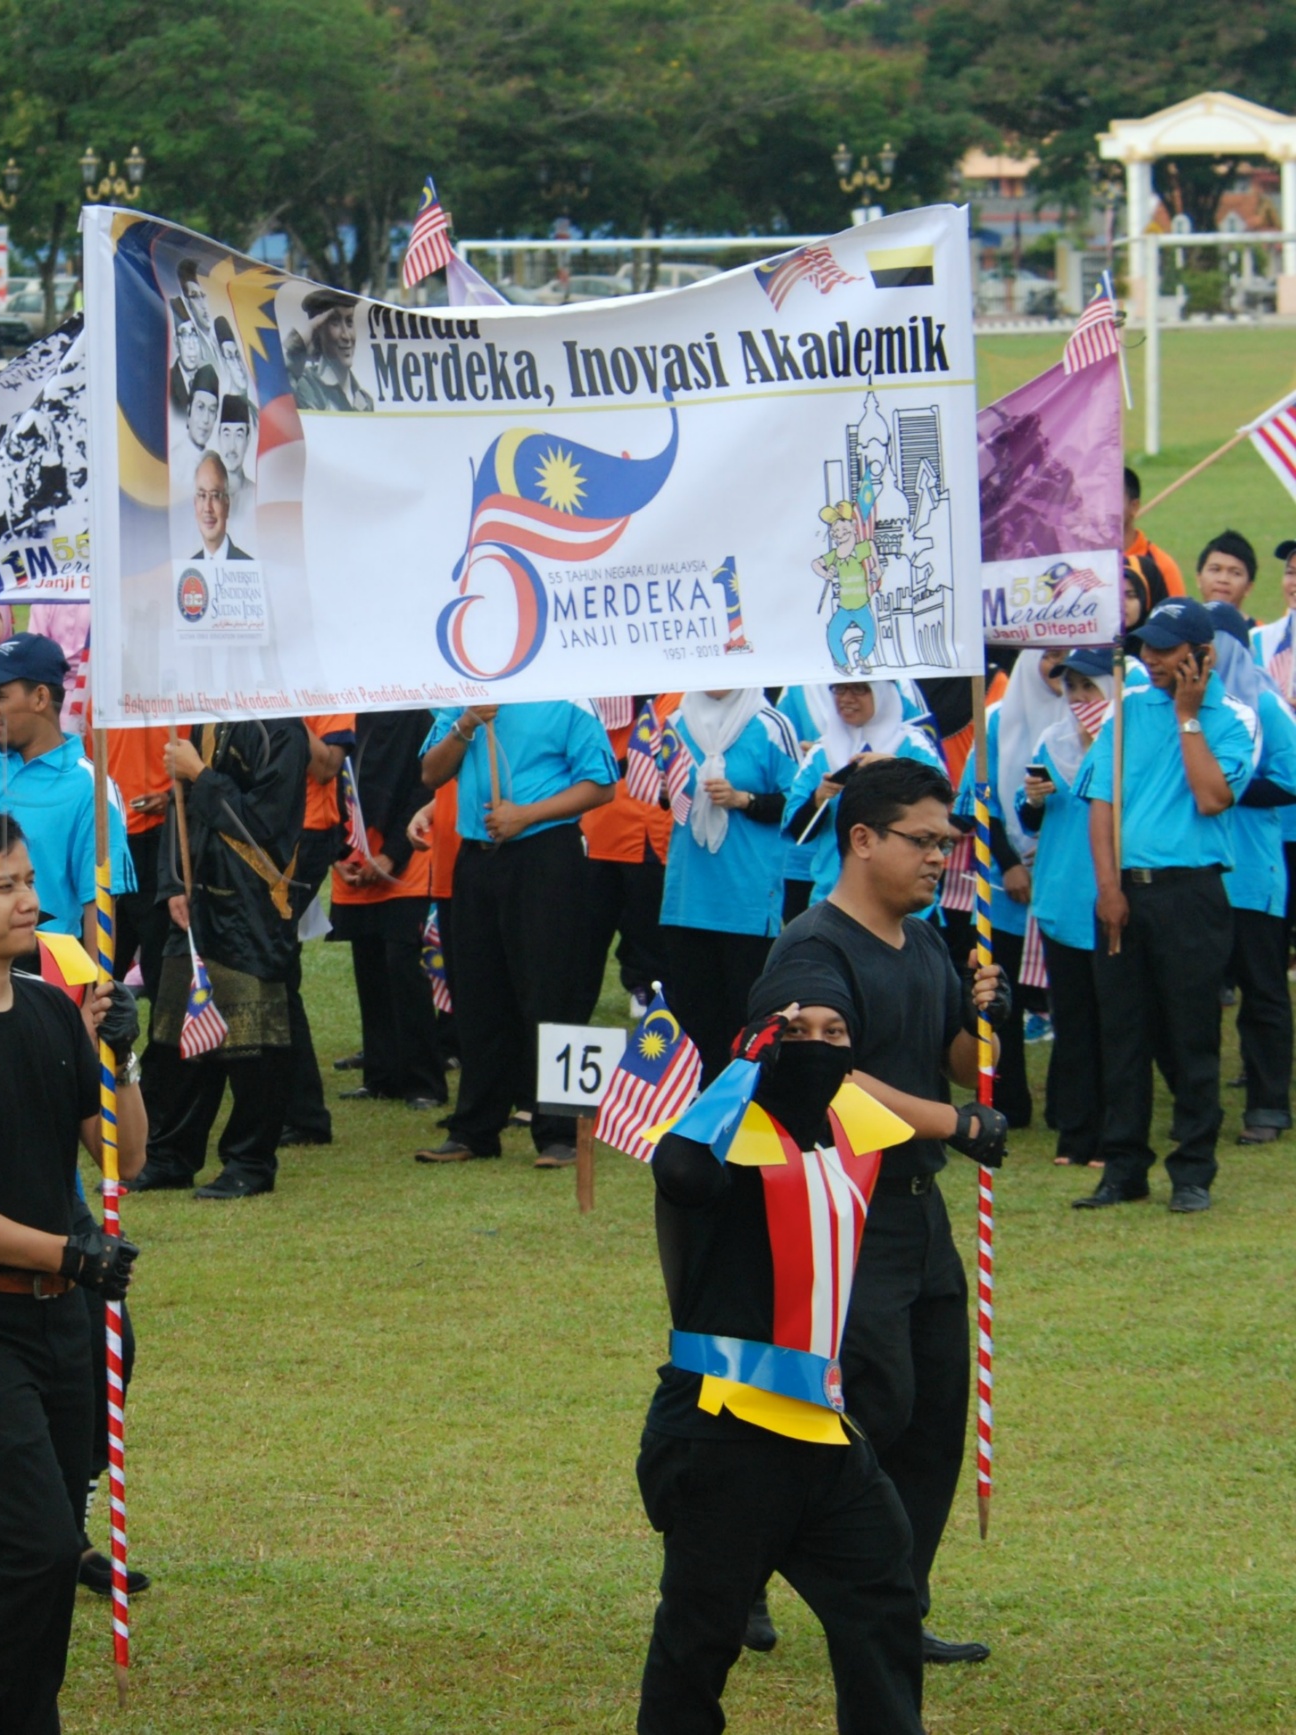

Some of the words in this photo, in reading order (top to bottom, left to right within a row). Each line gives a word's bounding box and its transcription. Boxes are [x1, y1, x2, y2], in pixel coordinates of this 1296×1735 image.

[370, 342, 555, 407] Merdeka,
[562, 332, 730, 398] Inovasi
[737, 315, 950, 384] Akademik
[35, 575, 75, 592] Janji
[215, 567, 260, 588] UNIVERSITI
[548, 571, 564, 585] 55
[565, 567, 602, 583] TAHUN
[604, 564, 644, 580] NEGARA
[646, 563, 658, 576] KU
[659, 559, 708, 575] MALAYSIA
[214, 584, 263, 603] PENDIDIKAN
[553, 577, 712, 622] MERDEKA
[211, 598, 242, 619] SULTAN
[559, 624, 618, 649] JANJI
[627, 616, 718, 645] DITEPATI
[992, 627, 1031, 641] Janji
[1034, 618, 1099, 638] Ditepati
[662, 648, 687, 661] 1957
[696, 645, 721, 659] 2012
[124, 693, 175, 718] Bahagian
[177, 691, 196, 712] Hal
[198, 690, 232, 711] Ehwal
[234, 688, 292, 710] Akademik
[302, 686, 361, 707] Universiti
[359, 683, 424, 703] Pendidikan
[422, 682, 459, 699] Sultan
[459, 680, 489, 698] Idris
[556, 1042, 603, 1095] 15
